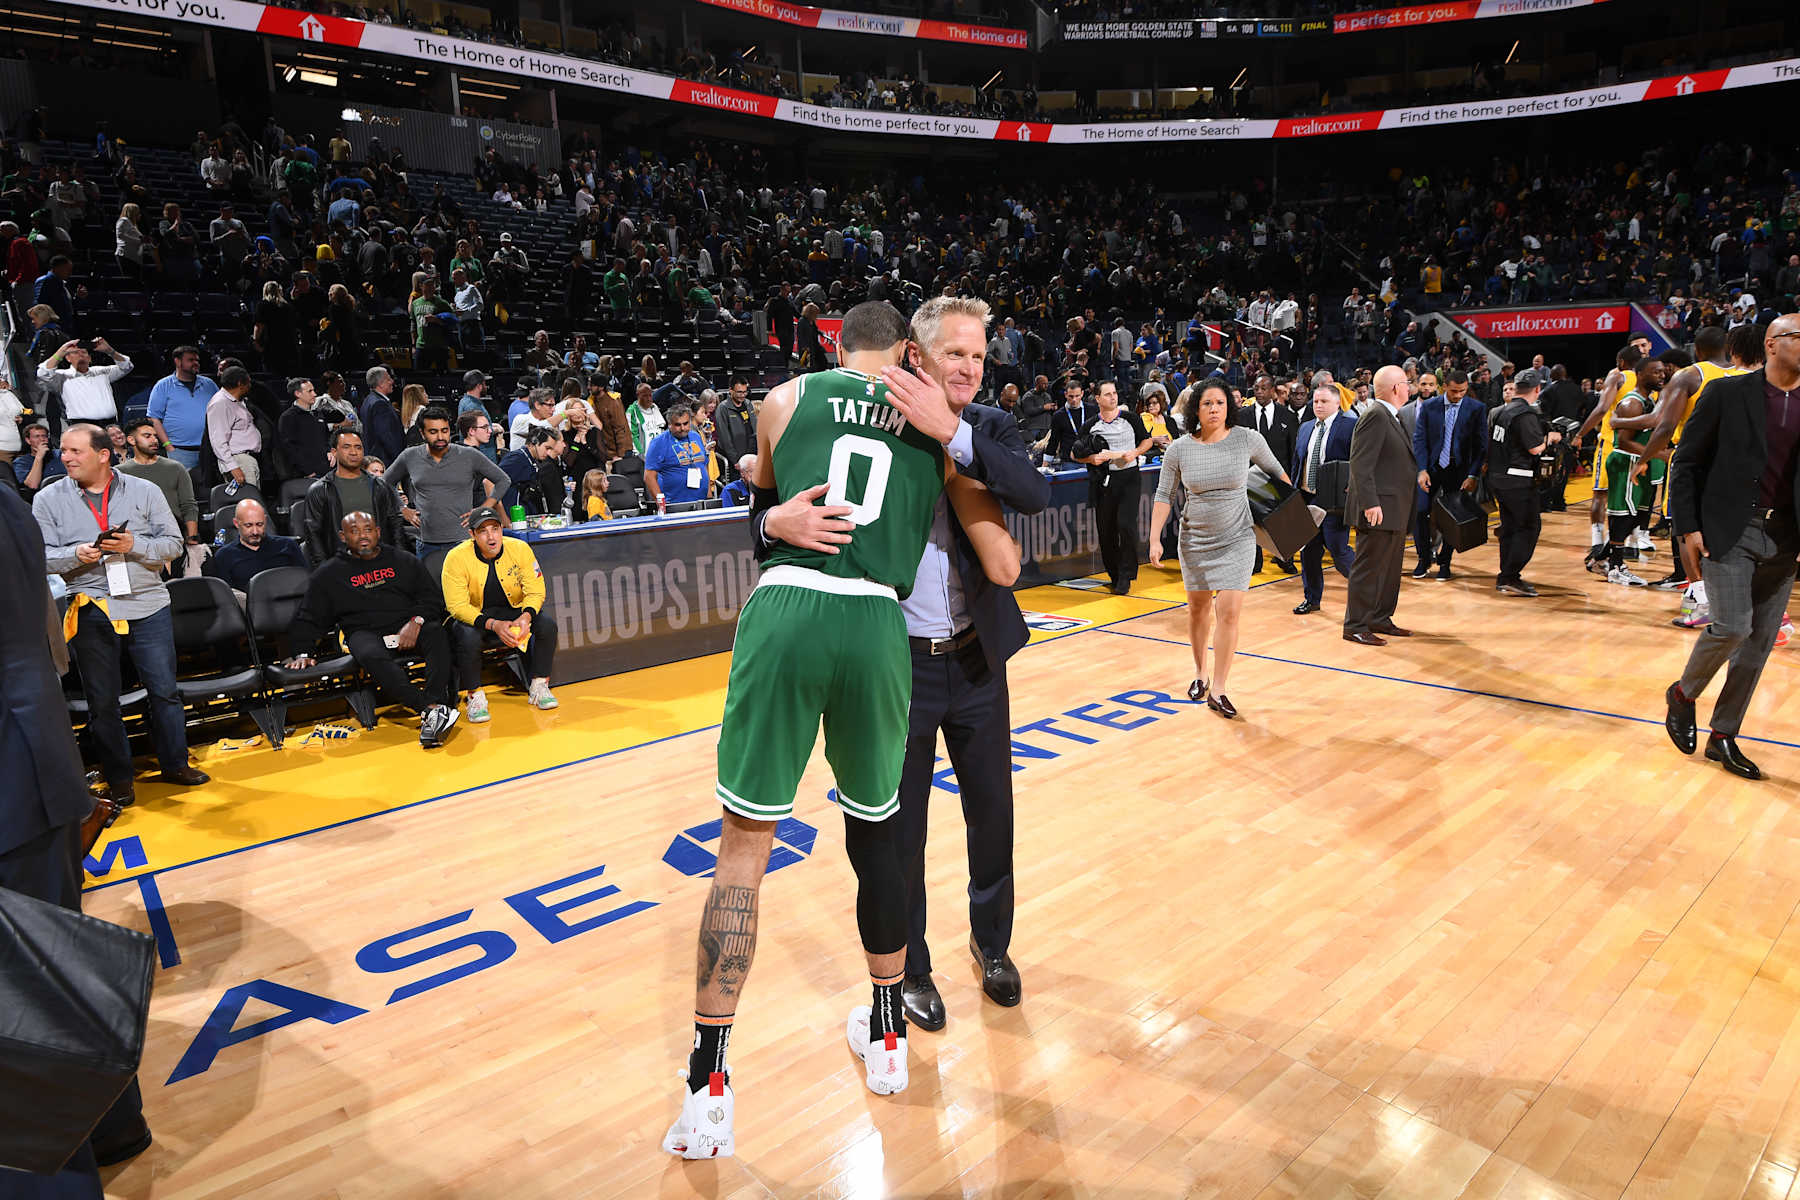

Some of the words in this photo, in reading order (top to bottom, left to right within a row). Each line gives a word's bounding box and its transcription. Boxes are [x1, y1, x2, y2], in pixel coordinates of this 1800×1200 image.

[177, 1, 225, 20] you.
[757, 1, 774, 14] for
[776, 7, 800, 20] you.
[1350, 13, 1401, 30] perfect
[1404, 10, 1424, 23] for
[1427, 8, 1457, 23] you.
[837, 15, 902, 33] realtor.com
[1066, 23, 1080, 31] WE
[1081, 23, 1104, 31] HAVE
[1105, 23, 1130, 31] MORE
[1132, 22, 1165, 31] GOLDEN
[1167, 22, 1193, 30] STATE
[1280, 24, 1293, 33] 111
[1301, 21, 1328, 31] FINAL
[947, 26, 969, 39] The
[971, 28, 1004, 43] Home
[1006, 31, 1018, 44] of
[1064, 31, 1104, 40] WARRIORS
[1105, 31, 1150, 39] BASKETBALL
[1152, 30, 1181, 39] COMING
[1183, 30, 1193, 38] UP
[414, 38, 448, 57] The
[453, 45, 505, 66] Home
[509, 53, 525, 69] of
[530, 58, 577, 78] Home
[581, 67, 631, 88] Search
[690, 88, 760, 113] realtor.com
[1400, 109, 1430, 123] Find
[1434, 108, 1458, 120] the
[1462, 105, 1503, 118] home
[1507, 99, 1559, 116] perfect
[1563, 95, 1585, 108] for
[1588, 91, 1621, 106] you.
[793, 106, 818, 121] Find
[821, 110, 841, 125] the
[845, 114, 882, 128] home
[886, 117, 930, 132] perfect
[934, 120, 950, 133] for
[954, 123, 979, 136] you.
[1082, 128, 1104, 139] The
[1108, 127, 1143, 138] Home
[1147, 126, 1159, 137] of
[1161, 126, 1198, 137] Home
[1200, 124, 1240, 136] Search
[1292, 119, 1361, 136] realtor.com
[1491, 314, 1580, 333] realtor.com
[828, 397, 907, 437] TATUM
[824, 433, 893, 526] 0
[350, 567, 396, 588] SINNERS
[552, 558, 690, 651] HOOPS
[721, 886, 755, 911] JUST
[723, 934, 752, 957] QUIT
